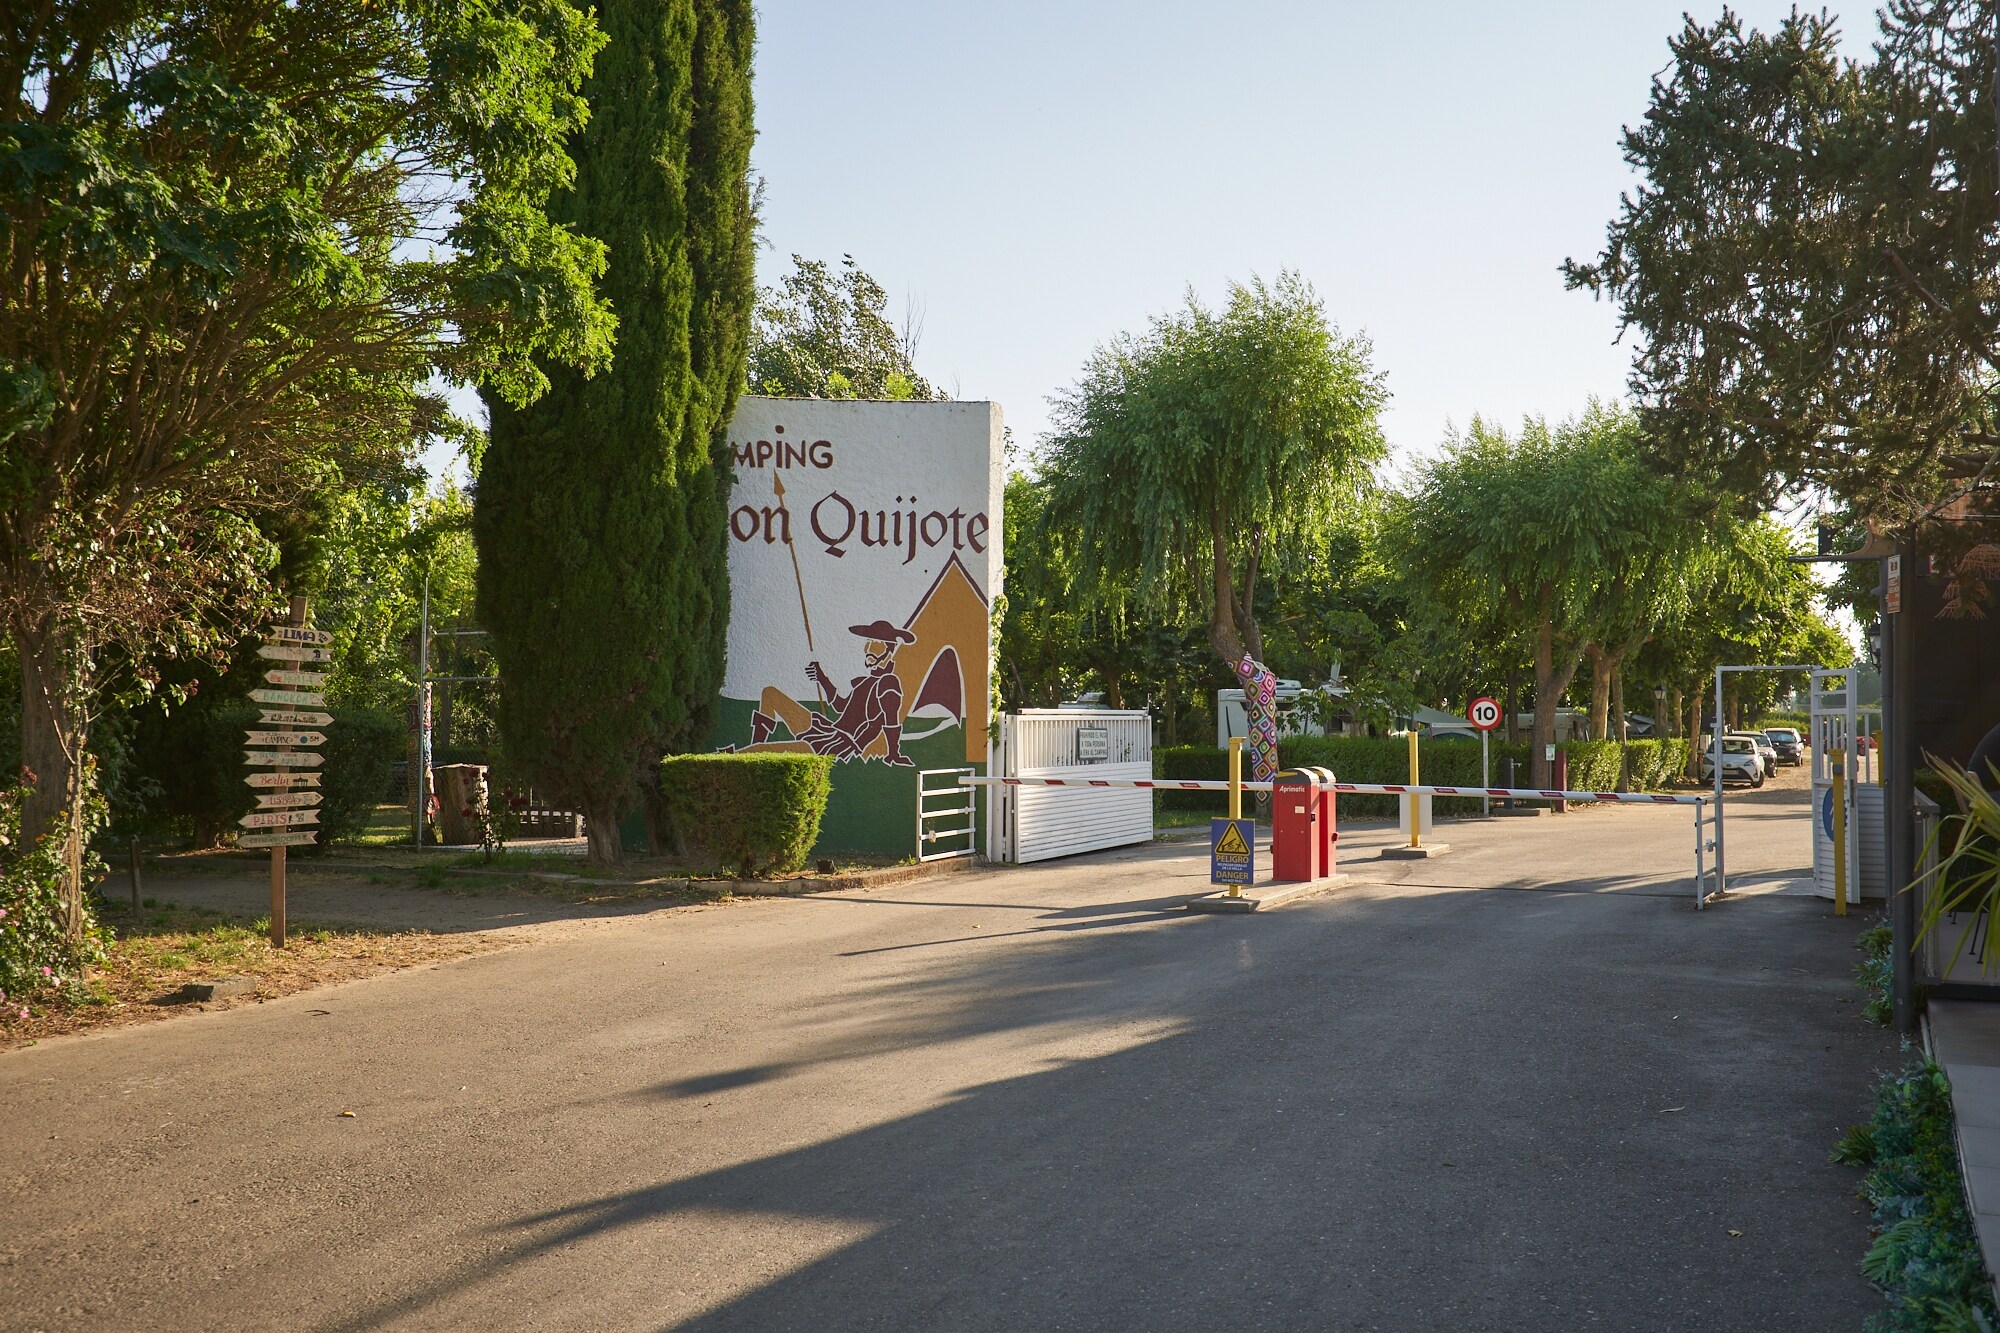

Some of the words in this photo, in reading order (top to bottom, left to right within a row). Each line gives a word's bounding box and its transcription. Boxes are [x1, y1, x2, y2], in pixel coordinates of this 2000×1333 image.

[810, 490, 989, 566] Quijote
[284, 629, 315, 641] LIMA
[263, 692, 308, 704] BANGKOK
[1476, 707, 1495, 720] 10
[261, 775, 289, 785] Berlin
[1279, 785, 1305, 793] Aprimatic
[1216, 855, 1249, 863] PELIGRO
[1216, 871, 1248, 879] DANGER
